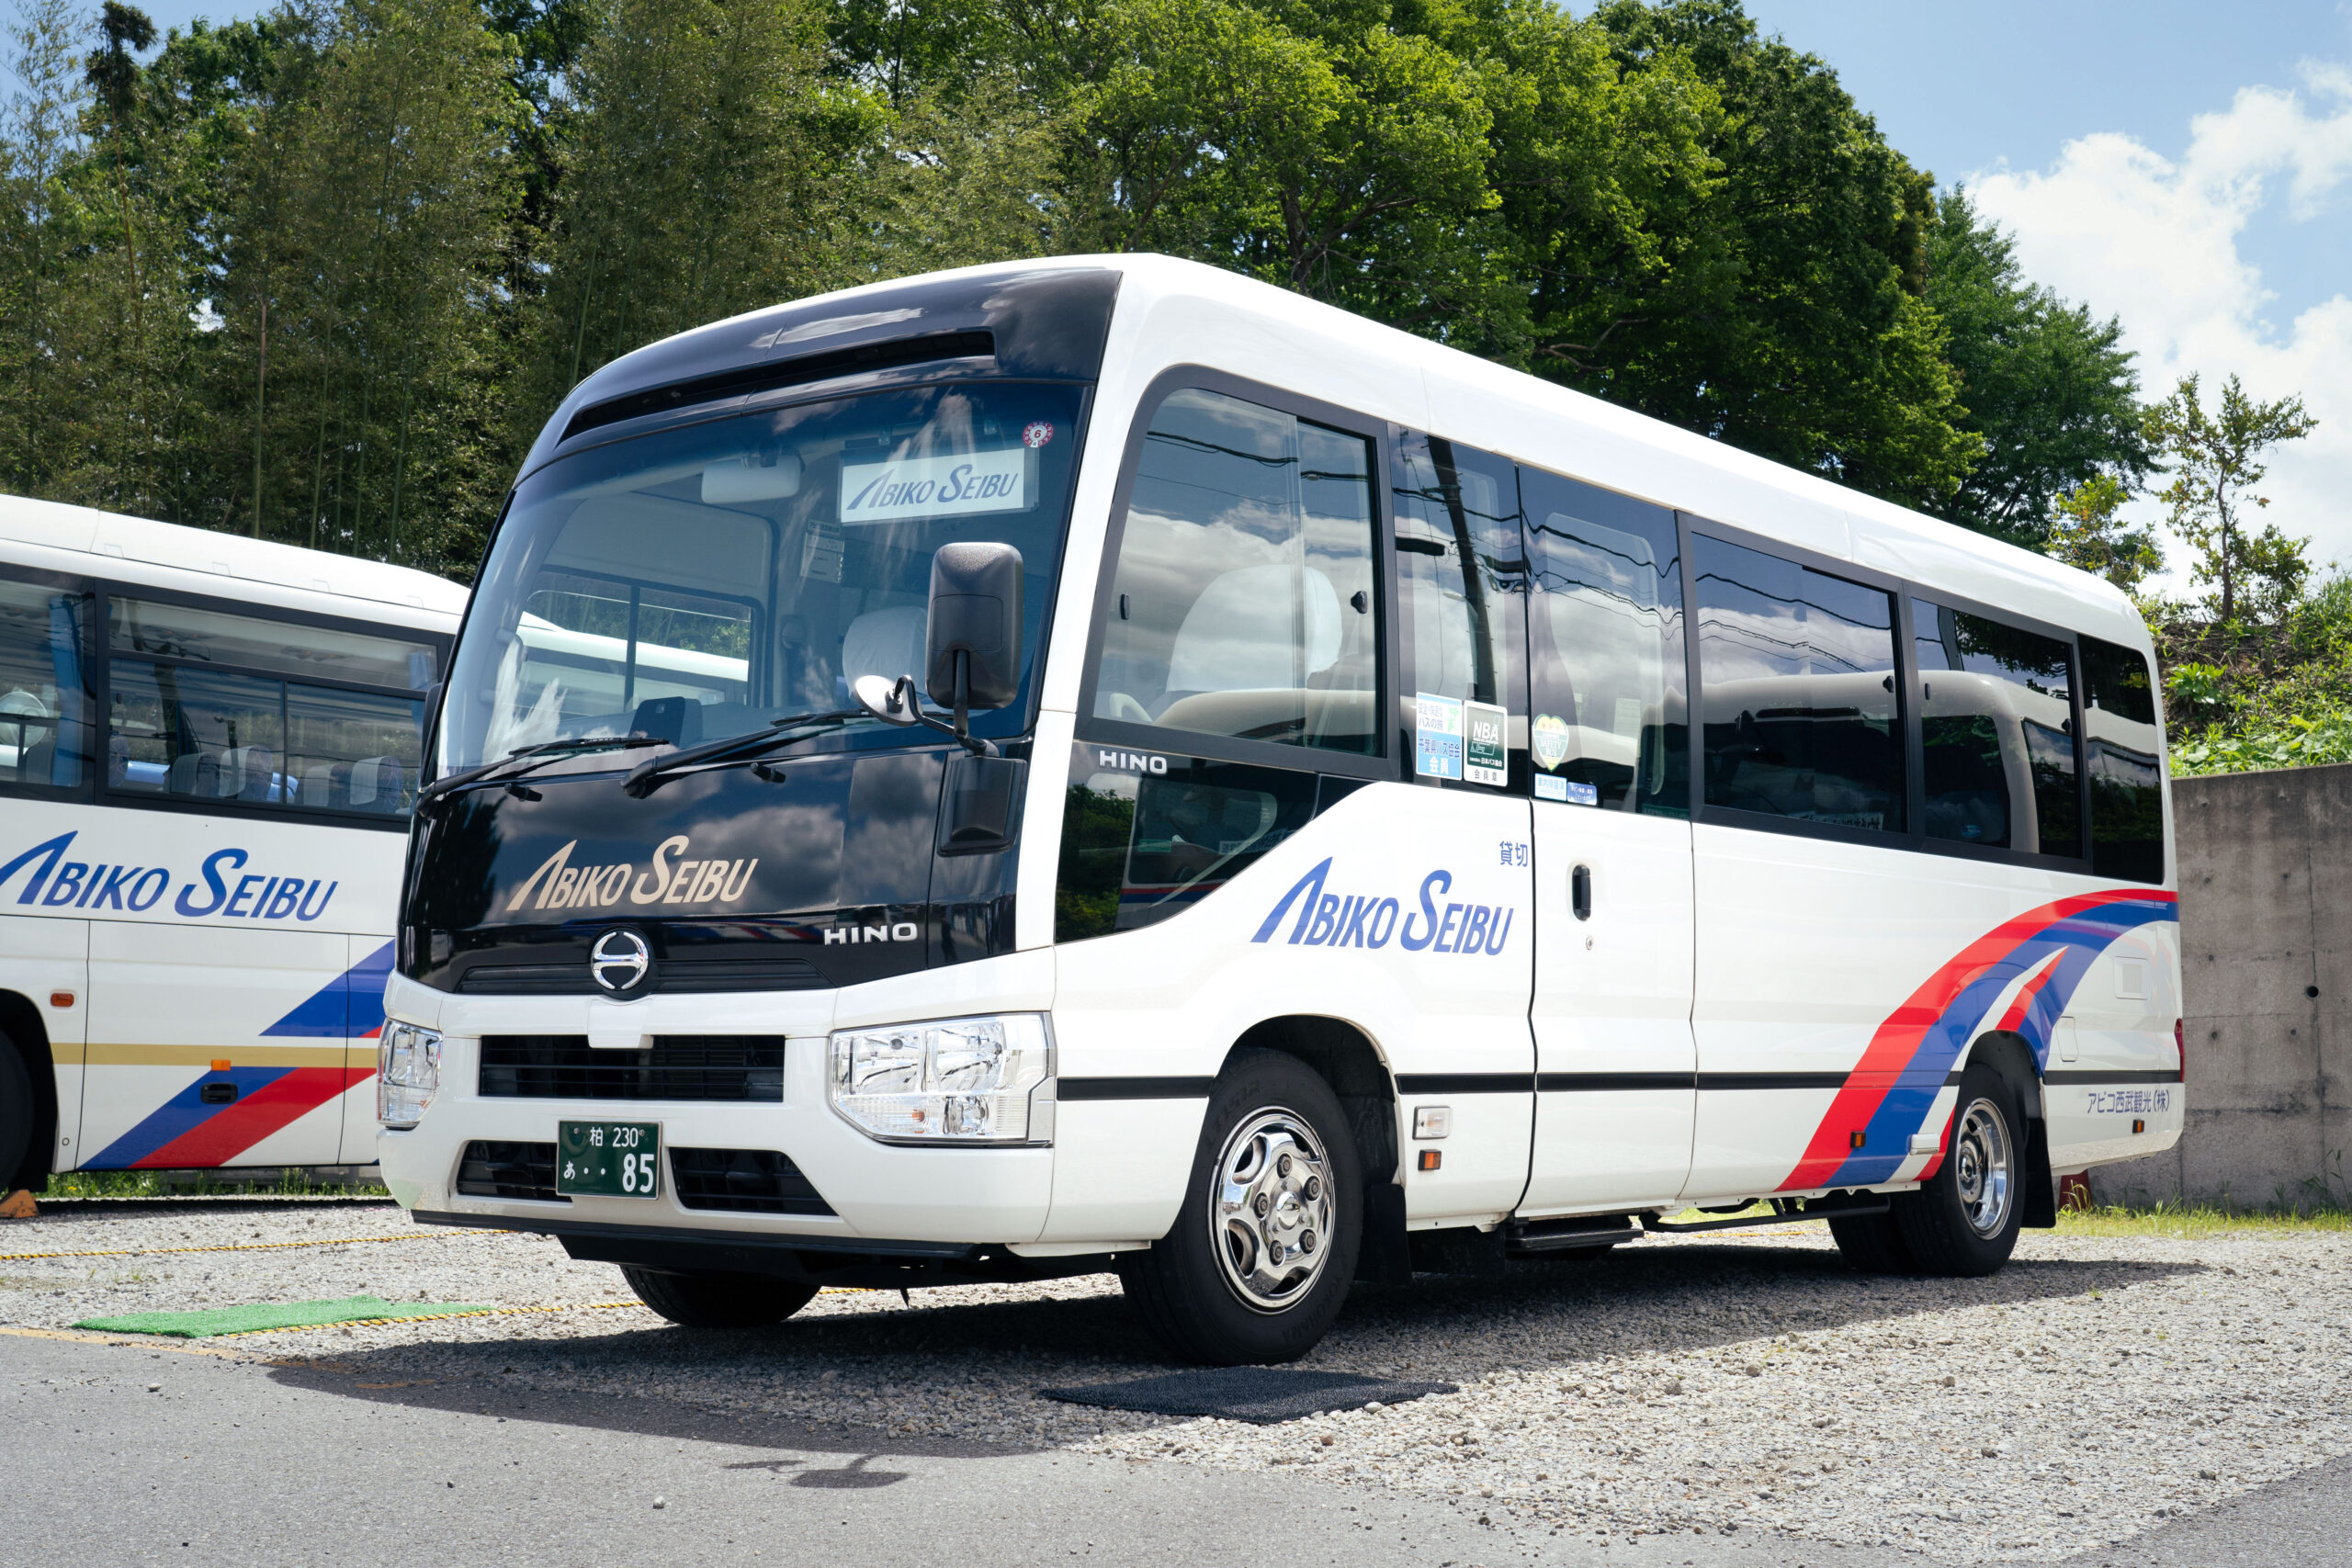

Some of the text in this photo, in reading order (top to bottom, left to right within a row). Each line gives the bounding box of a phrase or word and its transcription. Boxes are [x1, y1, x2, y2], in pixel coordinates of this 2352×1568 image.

[846, 464, 1019, 511] ABIKO SEIBU
[1473, 720, 1499, 741] NBA
[1418, 738, 1460, 759] 千葉県バス協会
[1099, 750, 1168, 775] HINO
[1429, 756, 1449, 775] 会員
[1499, 840, 1529, 868] 貸切
[0, 829, 339, 922] ABIKO SEIBU
[505, 834, 759, 911] ABIKO SEIBU
[1250, 856, 1515, 956] ABIKO SEIBU
[824, 921, 919, 947] HINO
[589, 1126, 639, 1148] 柏 230
[563, 1153, 655, 1193] あ 85
